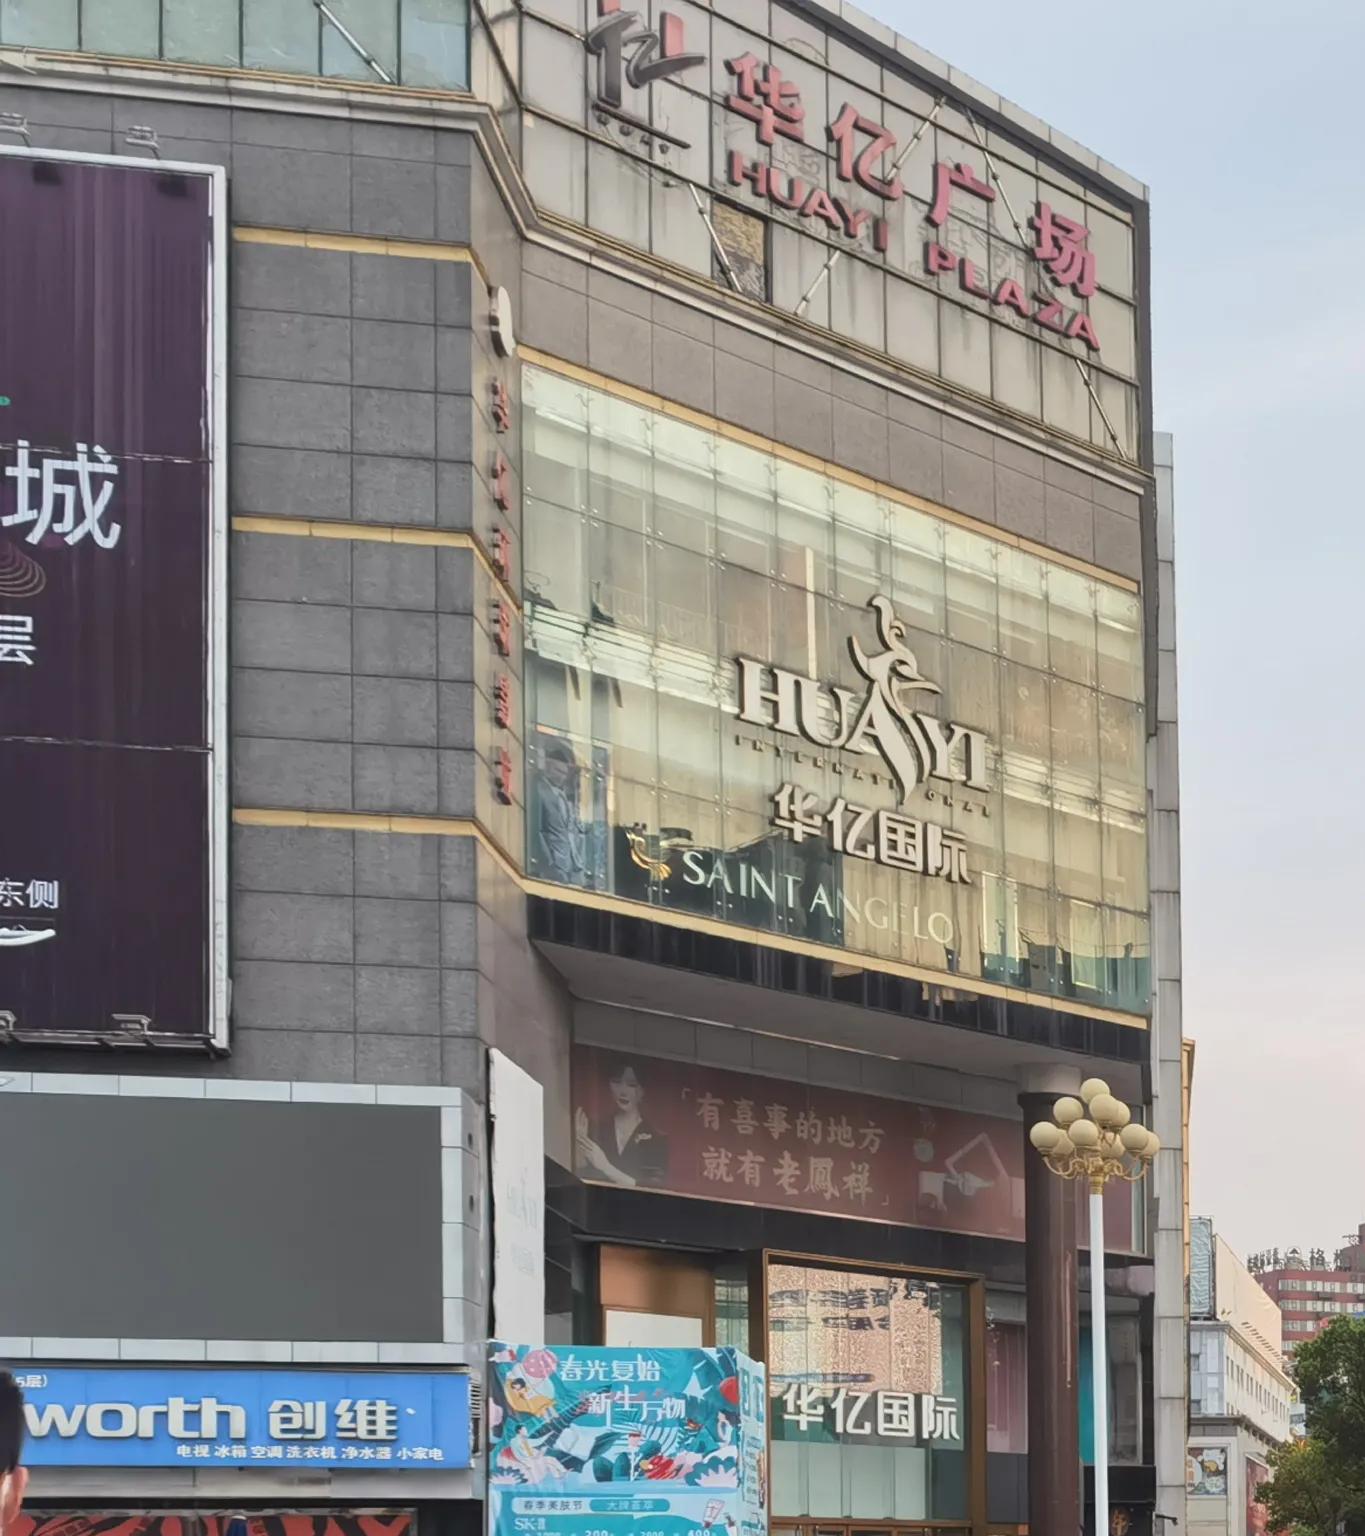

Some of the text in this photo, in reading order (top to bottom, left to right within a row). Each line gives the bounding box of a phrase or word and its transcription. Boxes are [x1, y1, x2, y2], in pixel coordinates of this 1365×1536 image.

[725, 52, 1097, 298] 华亿广场
[727, 151, 1100, 351] HUAYI PLAZA
[1, 440, 120, 550] 城
[735, 655, 990, 797] HUAYI
[773, 784, 972, 884] 华亿国际
[682, 849, 955, 946] SAINT ANGELO
[25, 1397, 398, 1440] worth 创维
[176, 1444, 209, 1459] 电视
[214, 1445, 247, 1459] 冰箱
[251, 1445, 283, 1459] 空调
[286, 1445, 338, 1460] 洗衣机
[396, 1446, 444, 1461] 小家电
[783, 1383, 960, 1440] 华亿国际
